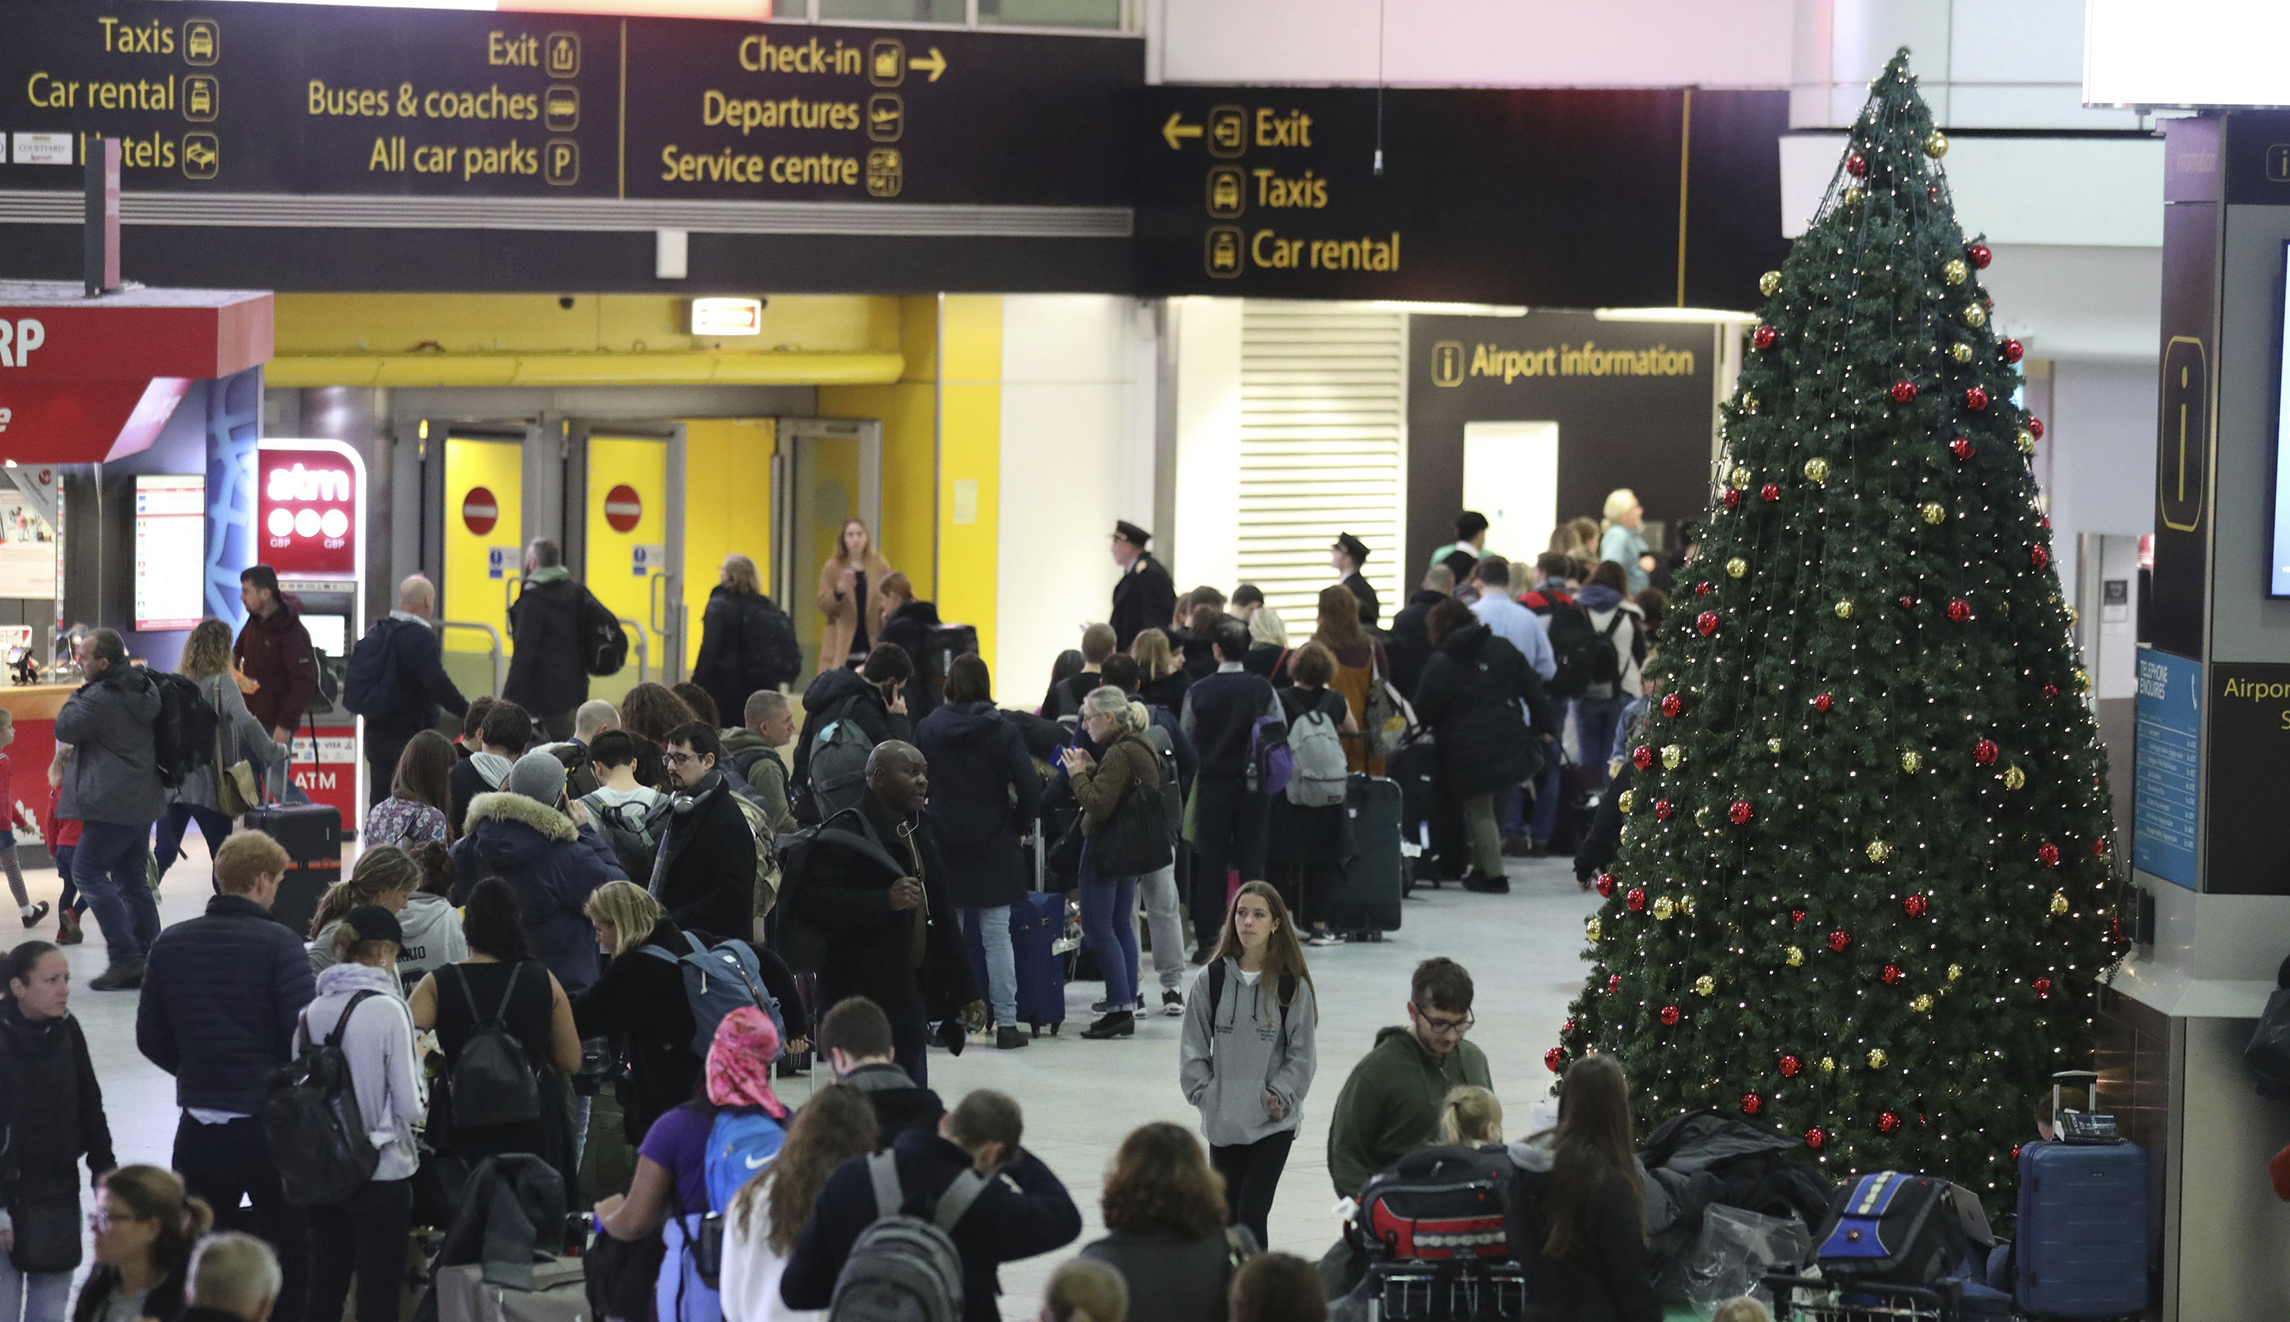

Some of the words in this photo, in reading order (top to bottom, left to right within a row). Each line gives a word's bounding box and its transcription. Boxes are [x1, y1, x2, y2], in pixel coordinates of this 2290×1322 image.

[98, 17, 175, 54] Taxis
[488, 31, 539, 67] Exit
[739, 35, 862, 75] Check-in
[28, 72, 80, 108] Car
[88, 75, 175, 111] rental
[308, 81, 389, 117] Buses
[397, 84, 418, 117] &
[425, 86, 538, 121] coaches
[703, 90, 860, 135] Departures
[1256, 108, 1312, 148] Exit
[370, 137, 405, 172] All
[413, 144, 457, 173] car
[465, 140, 539, 181] parks
[661, 145, 764, 184] Service
[770, 155, 859, 186] centre
[1254, 169, 1328, 209] Taxis
[1251, 228, 1304, 269] Car
[1310, 232, 1400, 272] rental
[1470, 341, 1556, 385] Airport
[1561, 341, 1695, 377] information
[267, 463, 350, 502] atm
[269, 537, 291, 548] GBP
[323, 538, 345, 549] GBP
[2139, 677, 2166, 701] ENQUIRIES
[2140, 659, 2168, 683] TELEPHONE
[294, 771, 337, 790] ATM
